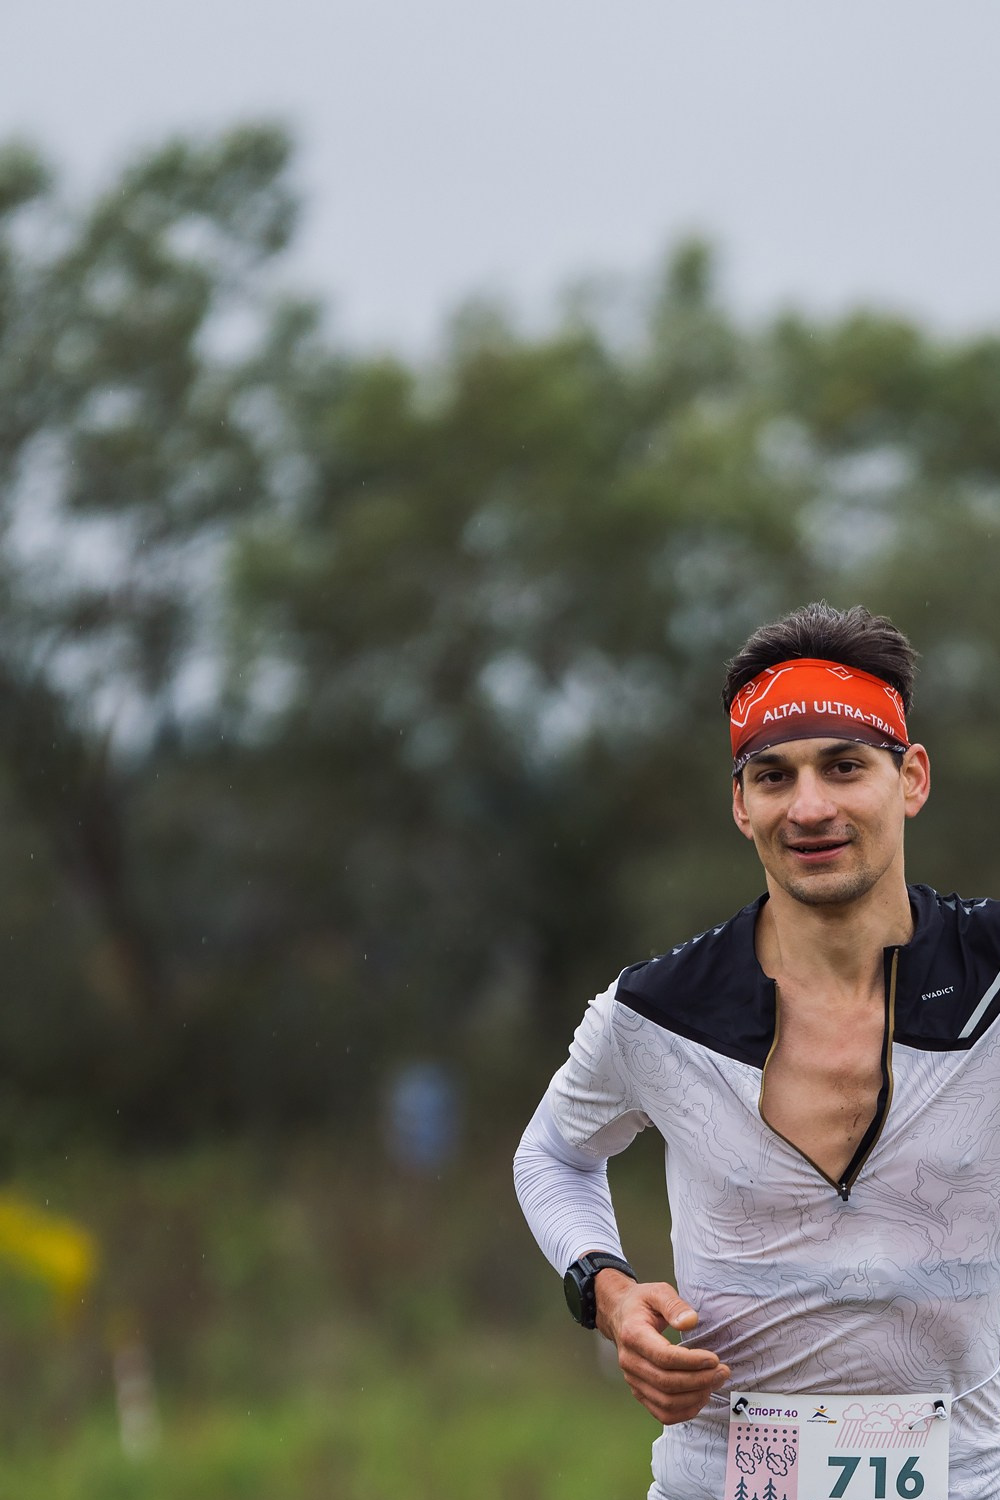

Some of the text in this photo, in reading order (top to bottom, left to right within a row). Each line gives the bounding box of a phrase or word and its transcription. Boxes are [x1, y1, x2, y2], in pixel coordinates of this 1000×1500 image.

[762, 701, 806, 724] ALTAI
[921, 986, 955, 1001] EVADICT
[748, 1407, 798, 1418] СПОРТ 40
[827, 1456, 925, 1500] 716
